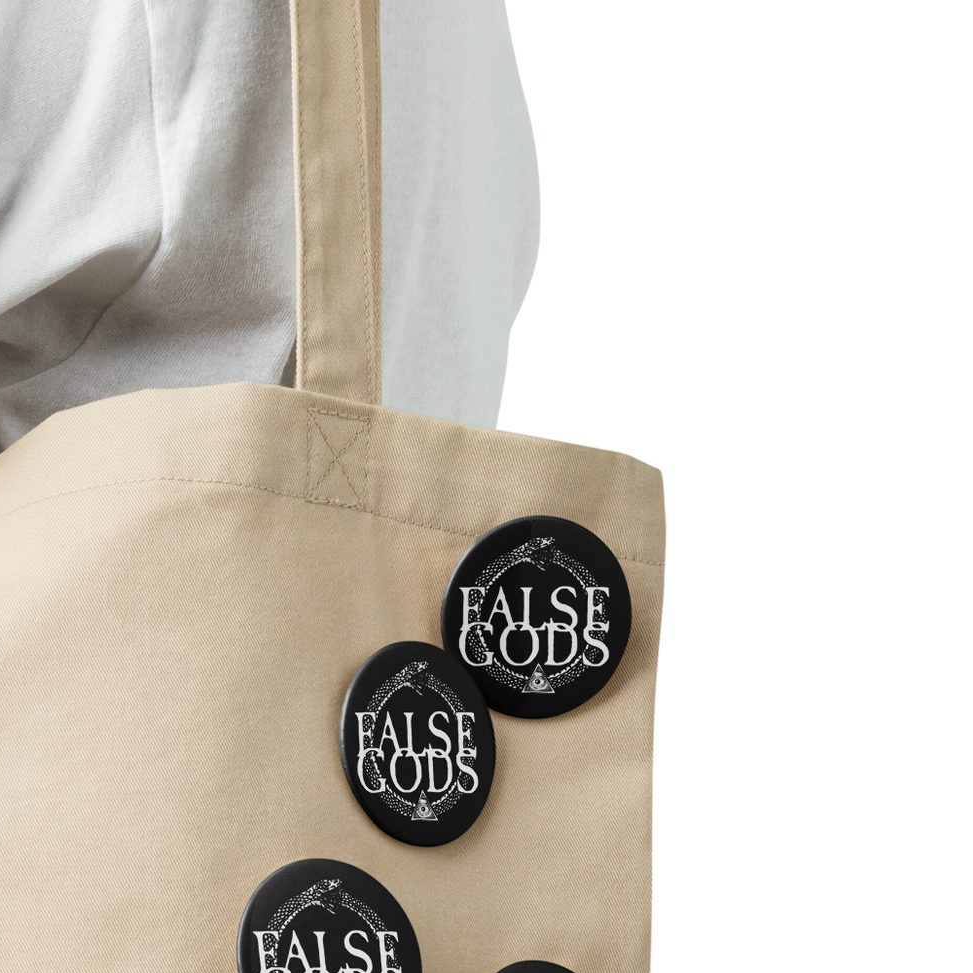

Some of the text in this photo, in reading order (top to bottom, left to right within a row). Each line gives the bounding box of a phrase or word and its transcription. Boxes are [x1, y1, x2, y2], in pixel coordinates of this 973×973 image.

[459, 586, 610, 632] FALSE
[459, 621, 610, 667] GODS
[354, 711, 477, 758] FALSE
[357, 748, 479, 793] GODS
